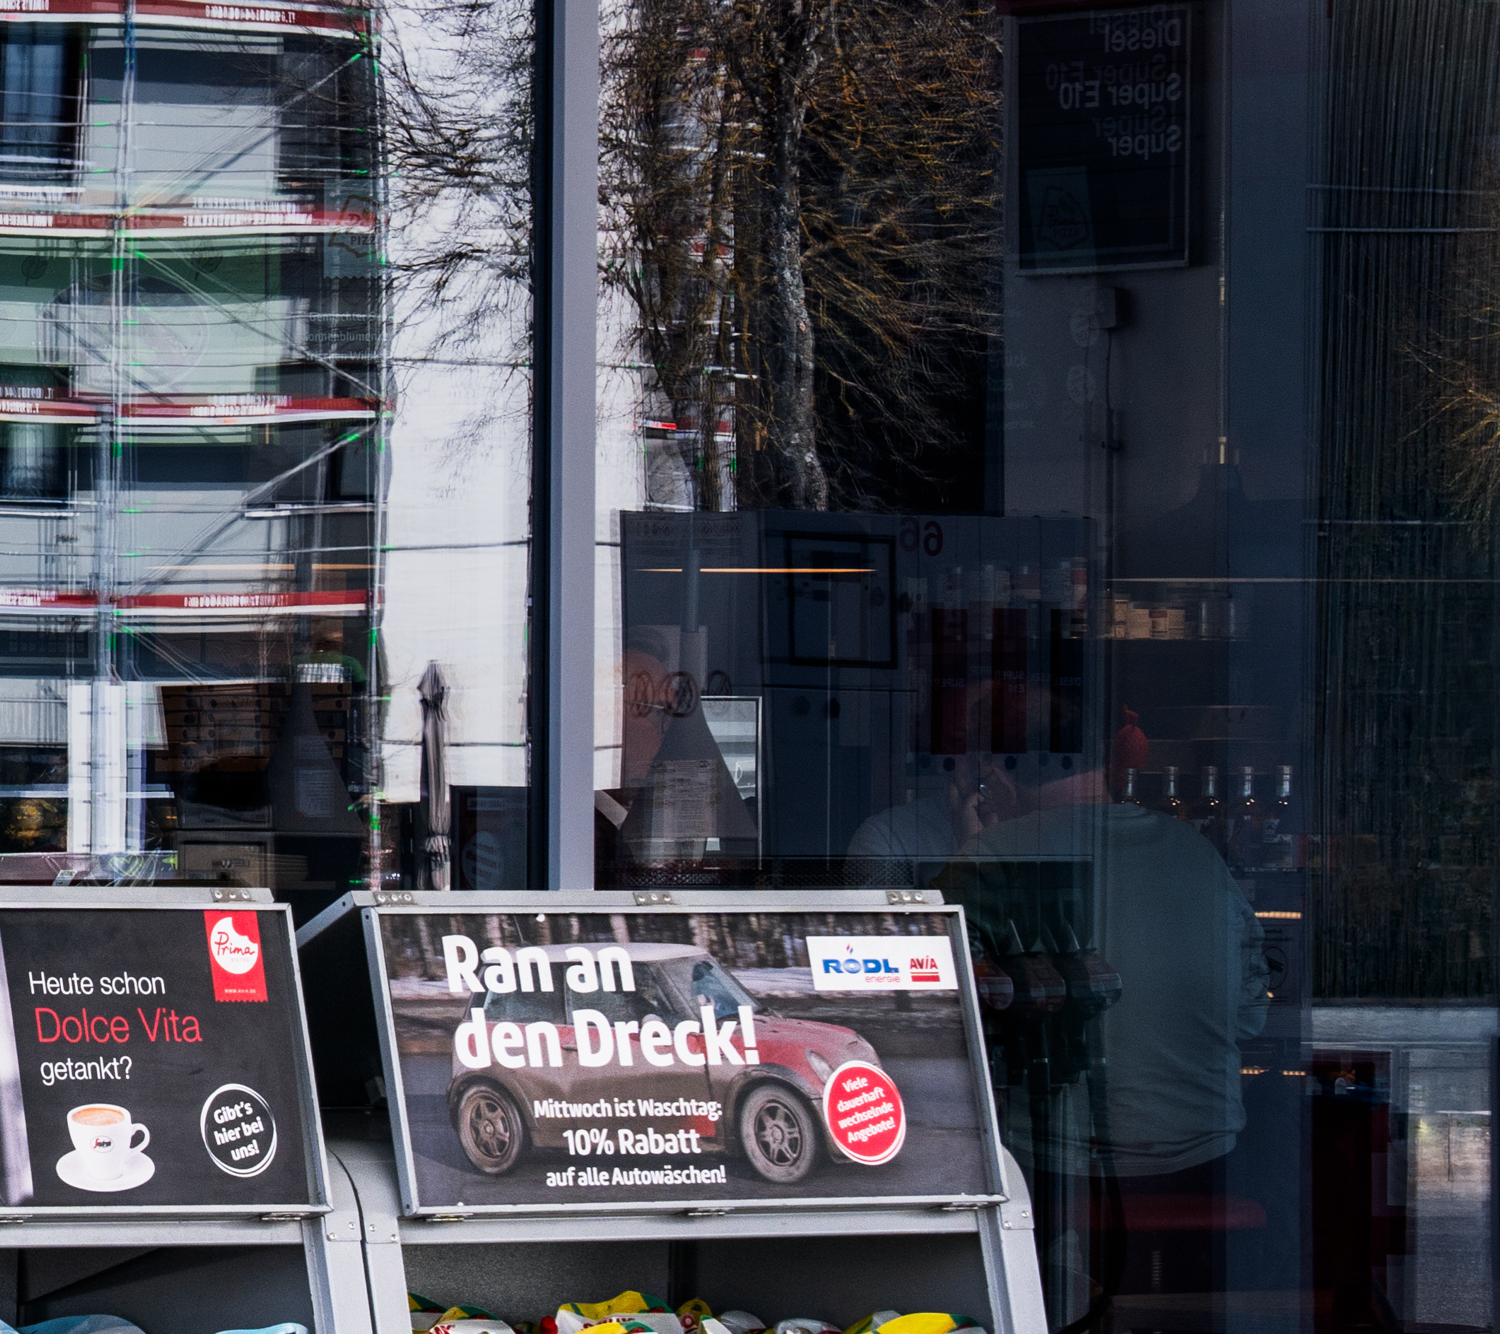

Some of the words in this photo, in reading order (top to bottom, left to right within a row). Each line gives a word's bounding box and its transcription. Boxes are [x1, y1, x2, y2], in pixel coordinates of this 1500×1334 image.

[441, 934, 554, 994] Ran
[565, 947, 636, 993] an
[909, 954, 938, 970] AVIA
[29, 971, 94, 997] Heute
[100, 971, 166, 997] schon
[865, 974, 901, 985] energie
[36, 1007, 130, 1044] Dolce
[138, 1007, 203, 1044] Vita
[455, 1008, 562, 1069] den
[572, 1005, 760, 1069] Dreck!
[40, 1056, 133, 1085] getankt?
[842, 1074, 869, 1093] Viele
[533, 1096, 610, 1119] Mittwoch
[614, 1097, 636, 1119] ist
[638, 1097, 722, 1122] Waschtag:
[836, 1087, 885, 1114] dauerhaft
[838, 1101, 895, 1129] wechselnde
[214, 1124, 243, 1146] hier
[242, 1118, 264, 1140] bei
[562, 1128, 614, 1156] 10%
[619, 1128, 701, 1155] Rabatt
[847, 1116, 896, 1144] Angebote!
[230, 1138, 260, 1162] uns!
[545, 1166, 575, 1187] auf
[577, 1166, 608, 1186] alle
[611, 1163, 726, 1186] Autowäschen!
